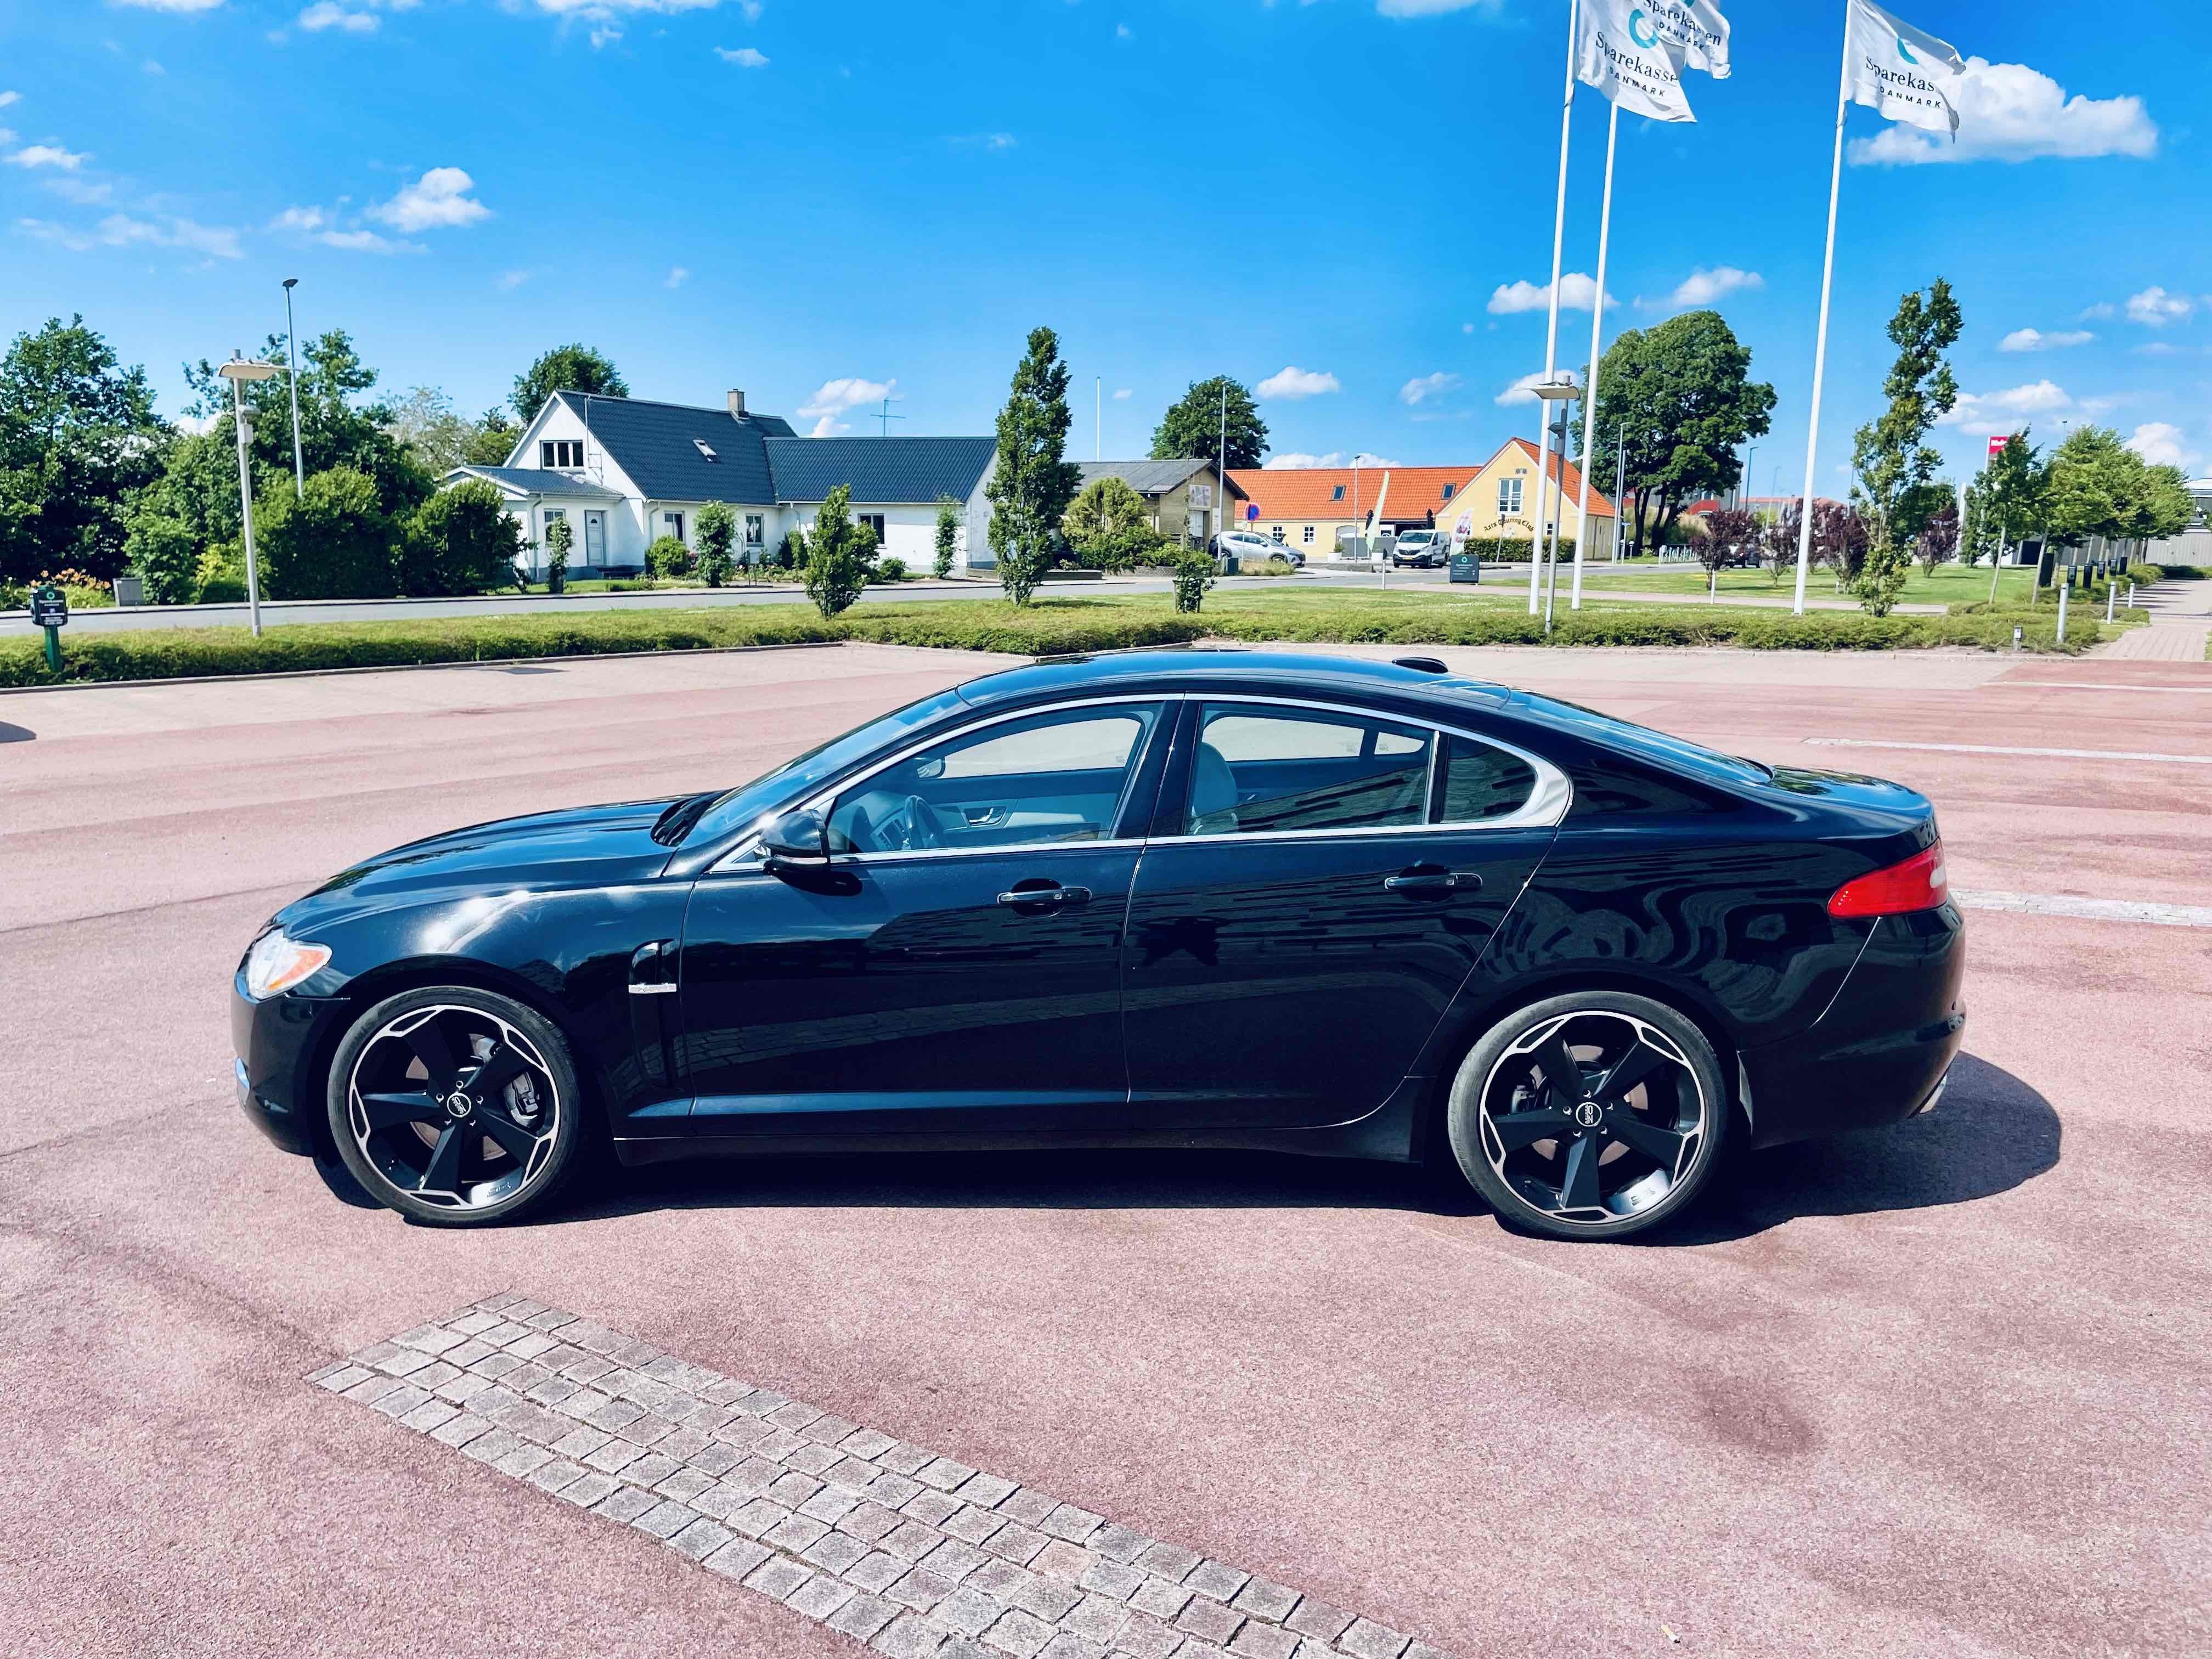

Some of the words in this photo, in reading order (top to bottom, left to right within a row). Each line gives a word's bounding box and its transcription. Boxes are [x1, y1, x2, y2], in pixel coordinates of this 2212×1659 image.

[1643, 0, 1720, 46] parekaen
[1610, 66, 1665, 97] DANMARK
[1880, 86, 1941, 108] DANMARK
